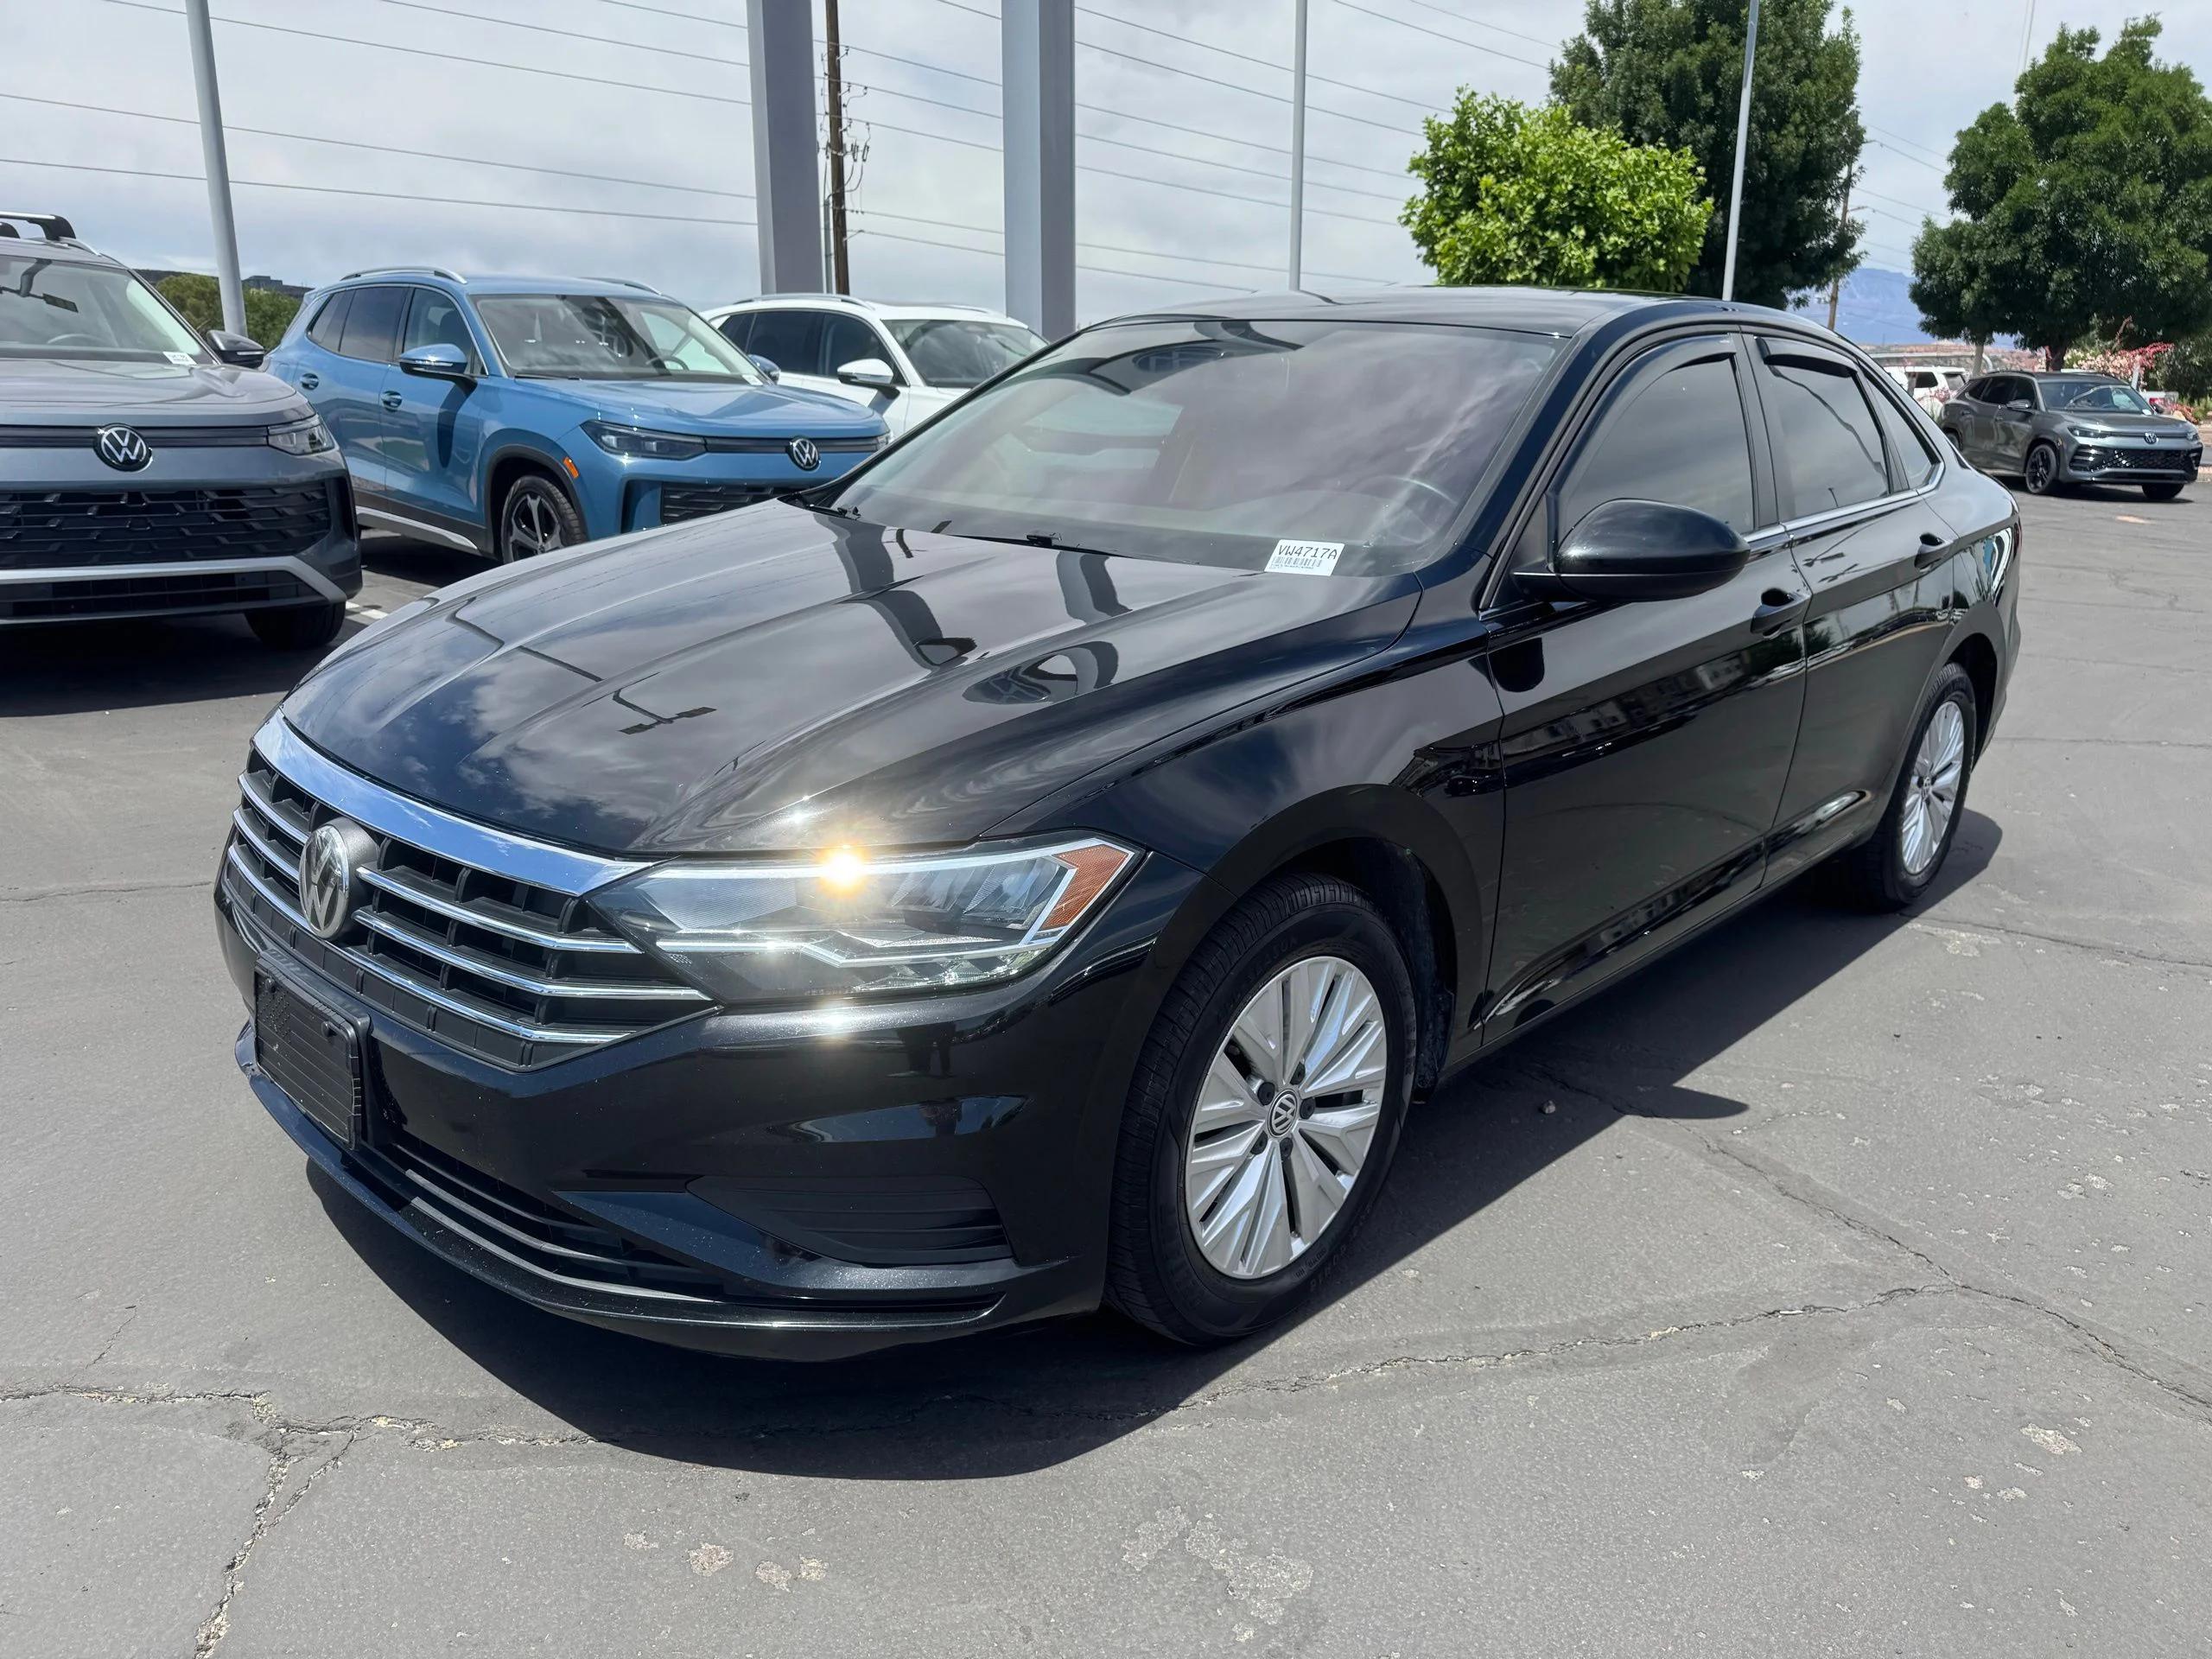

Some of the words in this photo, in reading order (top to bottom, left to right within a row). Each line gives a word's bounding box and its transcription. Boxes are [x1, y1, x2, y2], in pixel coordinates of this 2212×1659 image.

[101, 427, 147, 465] VW
[792, 438, 819, 468] VW
[1278, 544, 1338, 560] VW4717A
[300, 825, 349, 938] VW
[1272, 1093, 1297, 1134] VW
